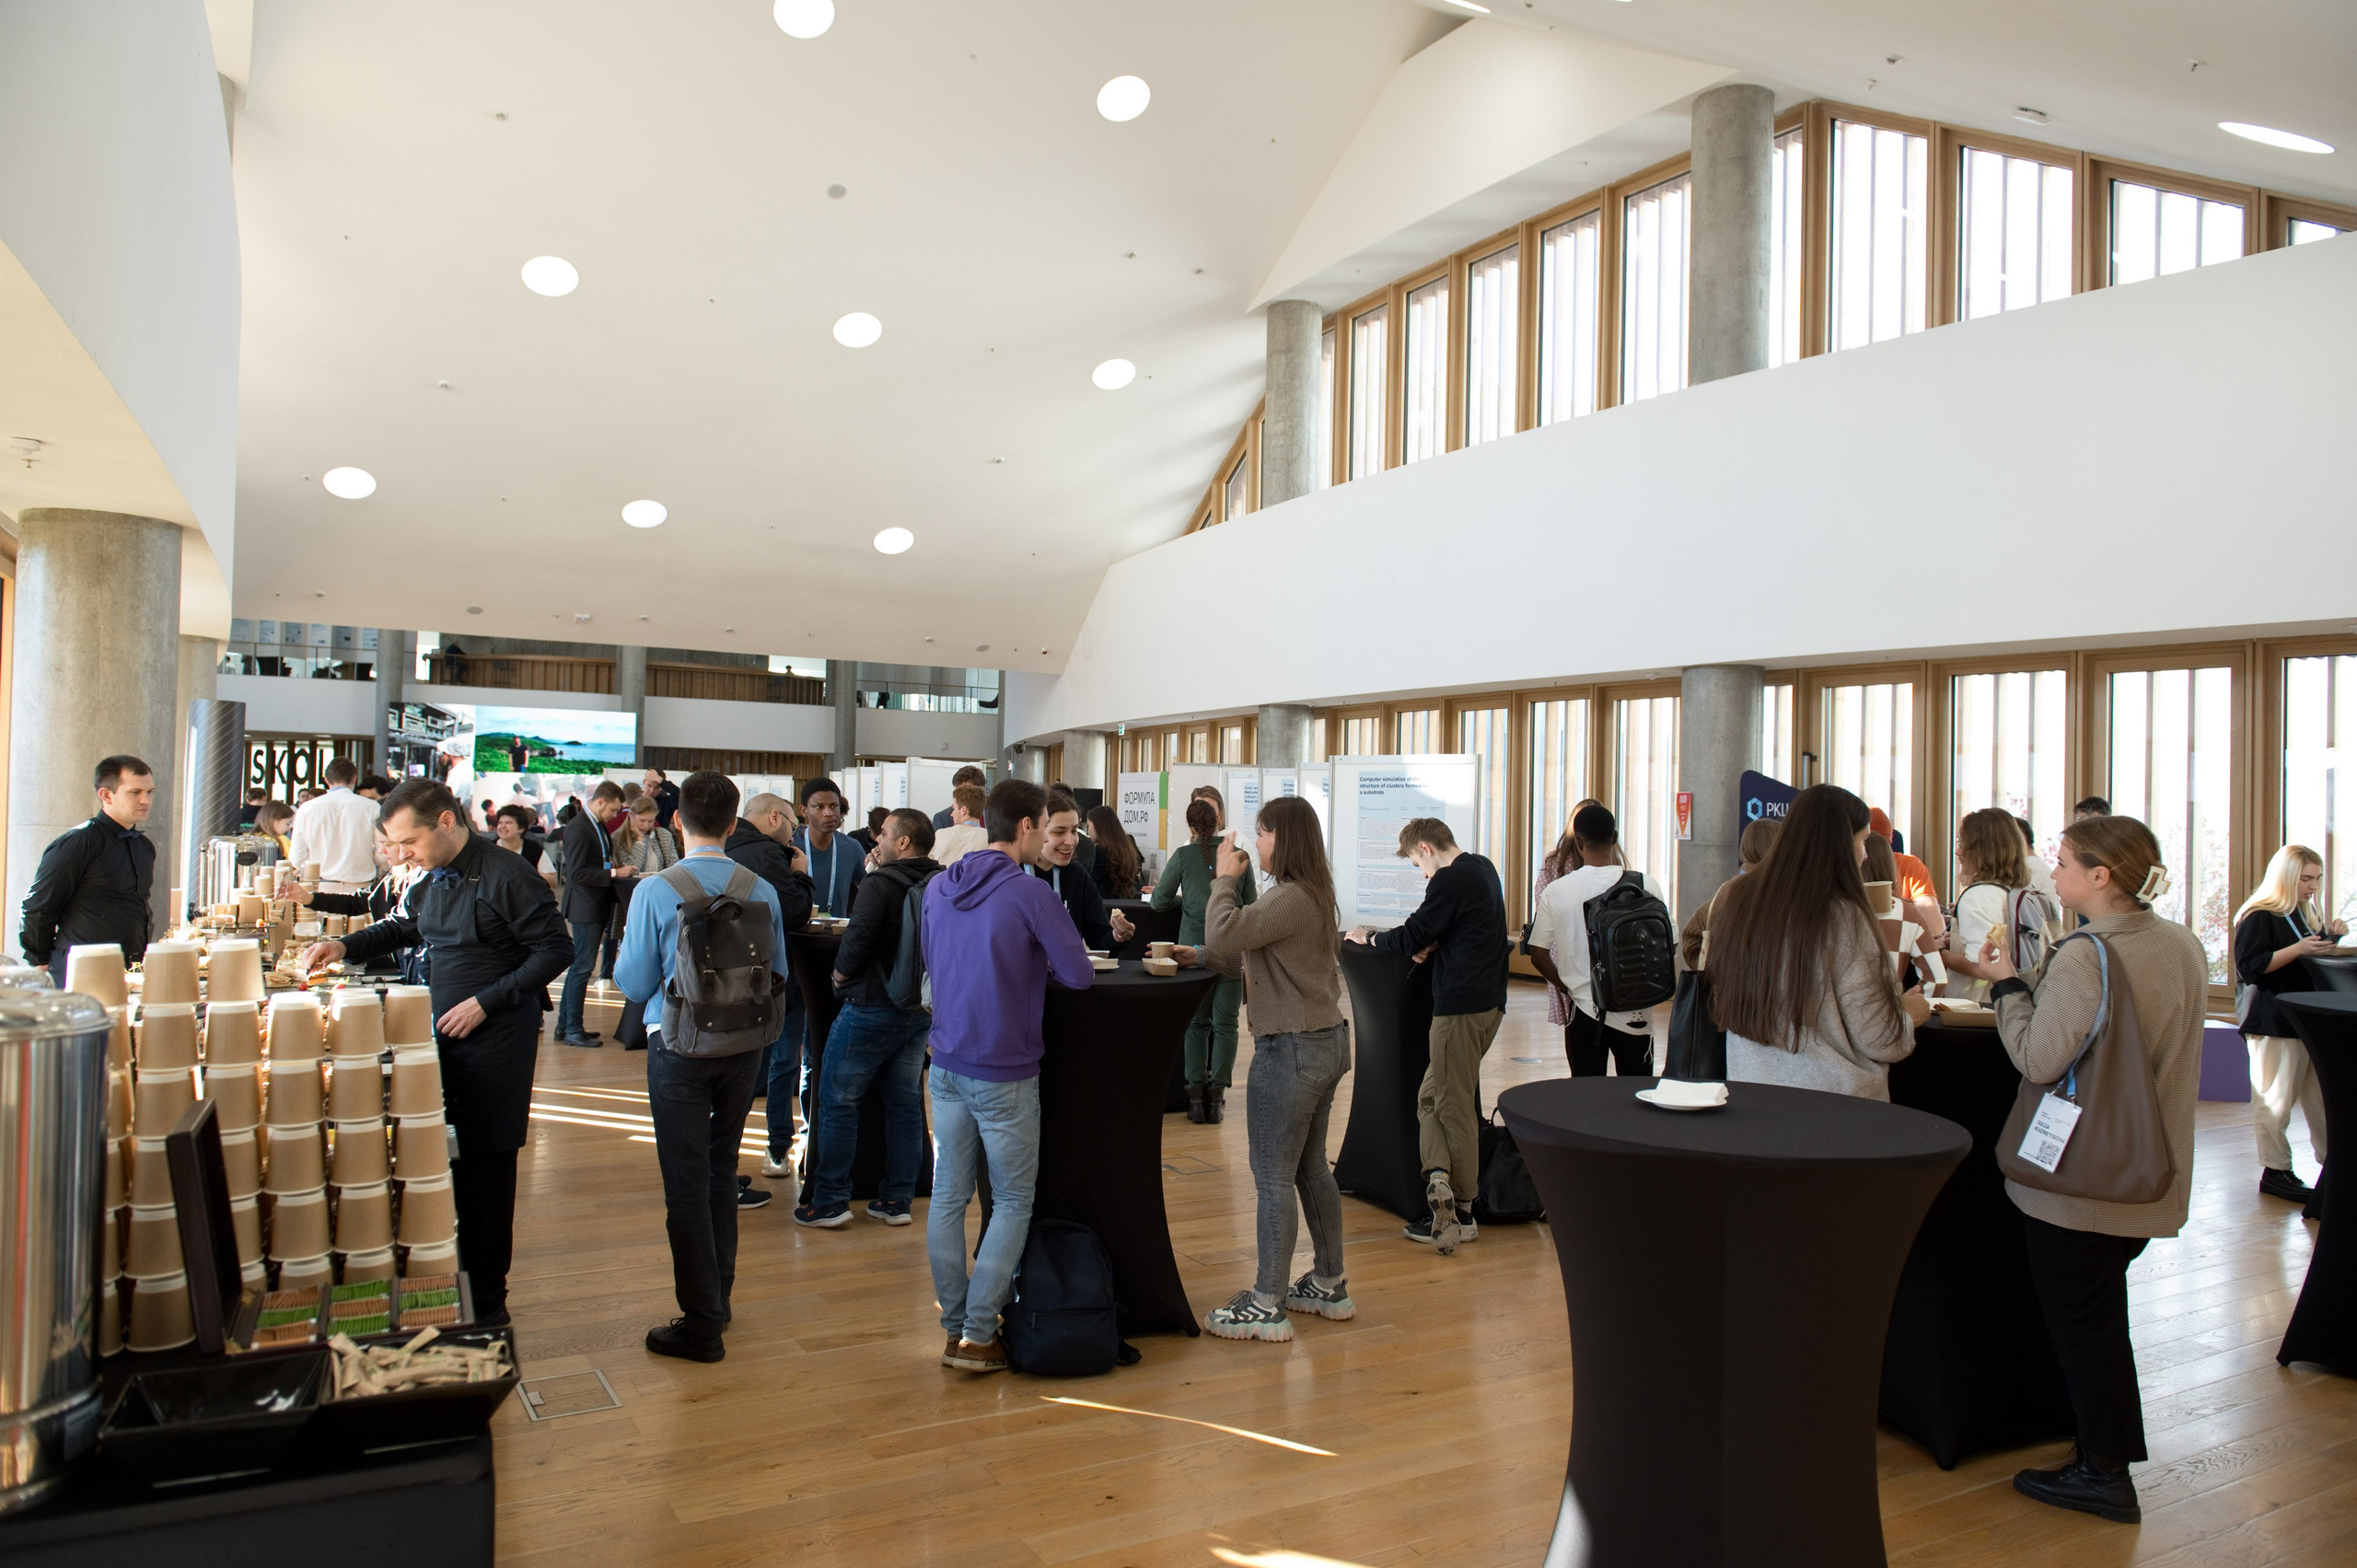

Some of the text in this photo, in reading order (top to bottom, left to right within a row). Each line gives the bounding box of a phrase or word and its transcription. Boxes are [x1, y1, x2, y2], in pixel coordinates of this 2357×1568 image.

[1124, 792, 1155, 805] ФОРМУЛА
[1124, 809, 1149, 825] ДОМ.РФ
[2037, 1120, 2049, 1130] JULIA
[2034, 1126, 2065, 1144] KUZNETSOVA
